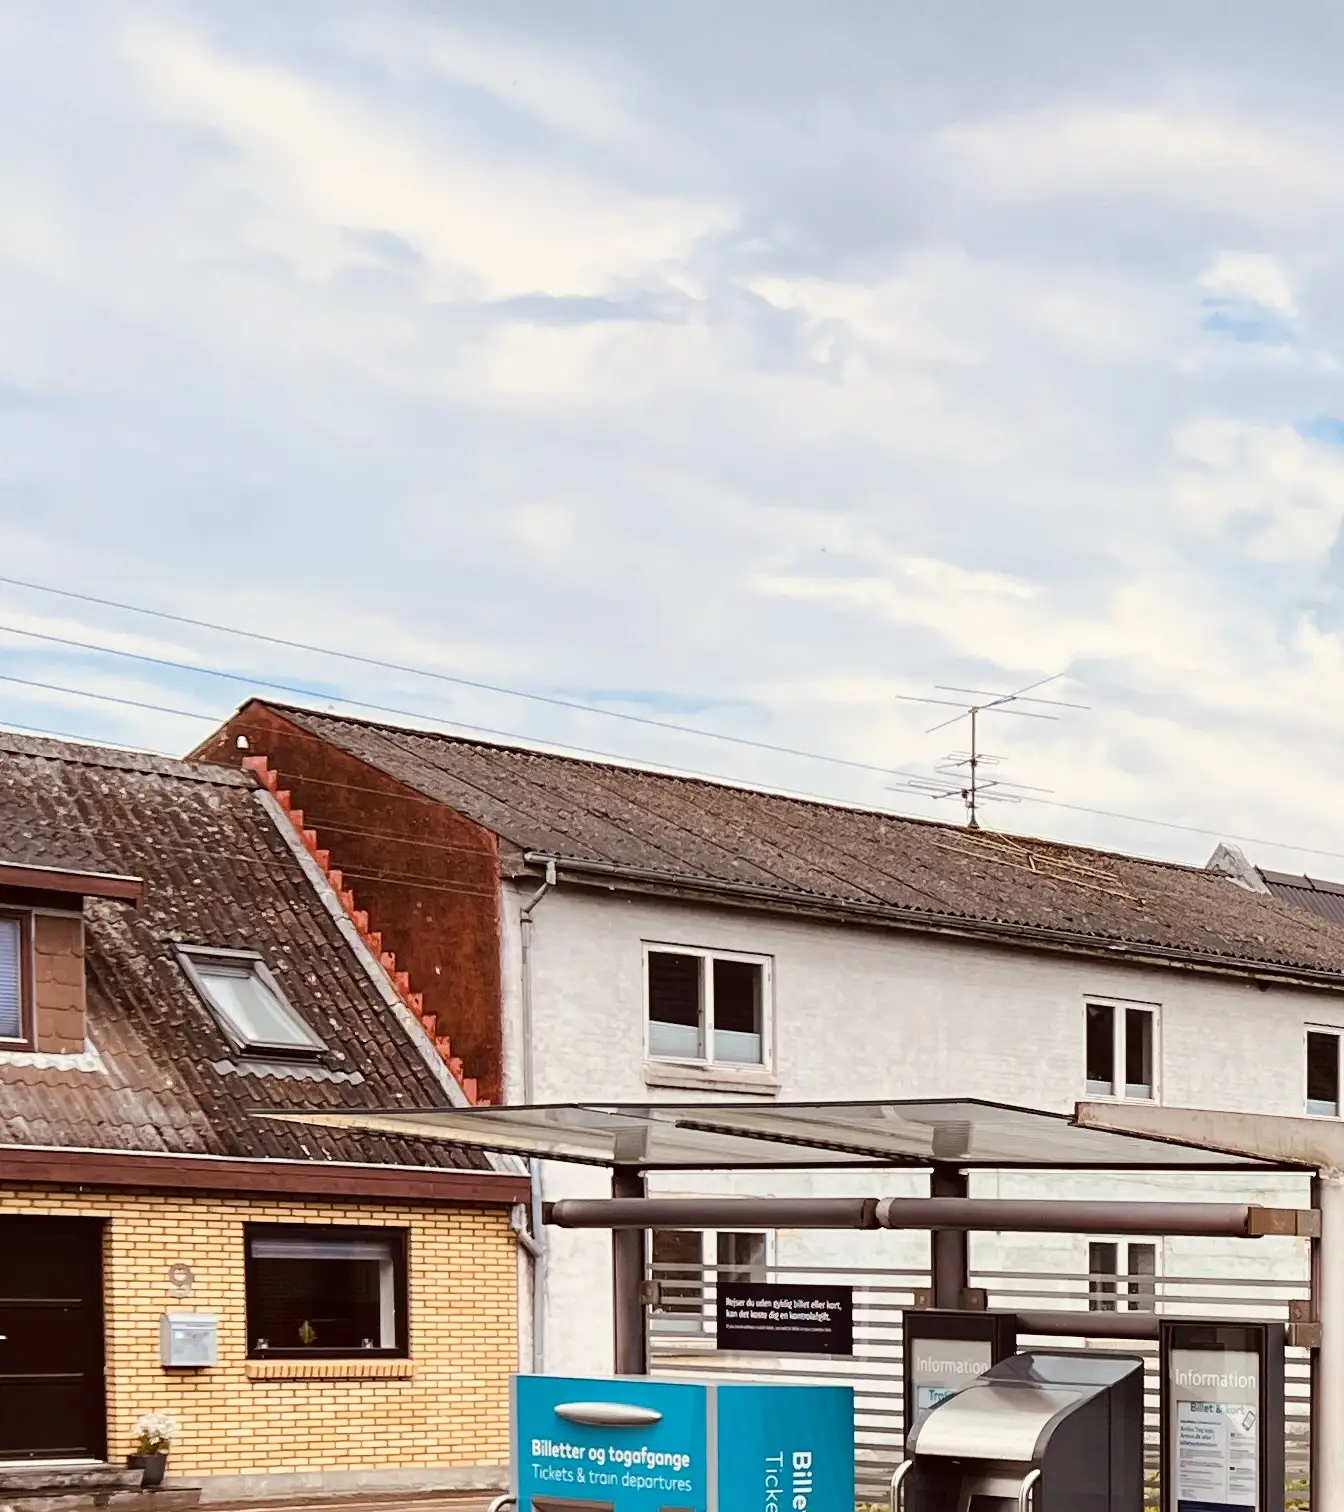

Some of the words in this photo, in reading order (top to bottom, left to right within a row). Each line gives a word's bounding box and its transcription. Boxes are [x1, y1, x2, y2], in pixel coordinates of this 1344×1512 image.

[167, 1263, 195, 1299] 9
[916, 1355, 989, 1376] Information
[1175, 1369, 1256, 1388] Information
[531, 1439, 585, 1460] Billetter
[588, 1447, 606, 1466] og
[609, 1446, 691, 1471] togafgange
[531, 1463, 574, 1483] Tickets
[576, 1467, 586, 1484] &
[589, 1469, 619, 1486] train
[621, 1471, 693, 1492] departures
